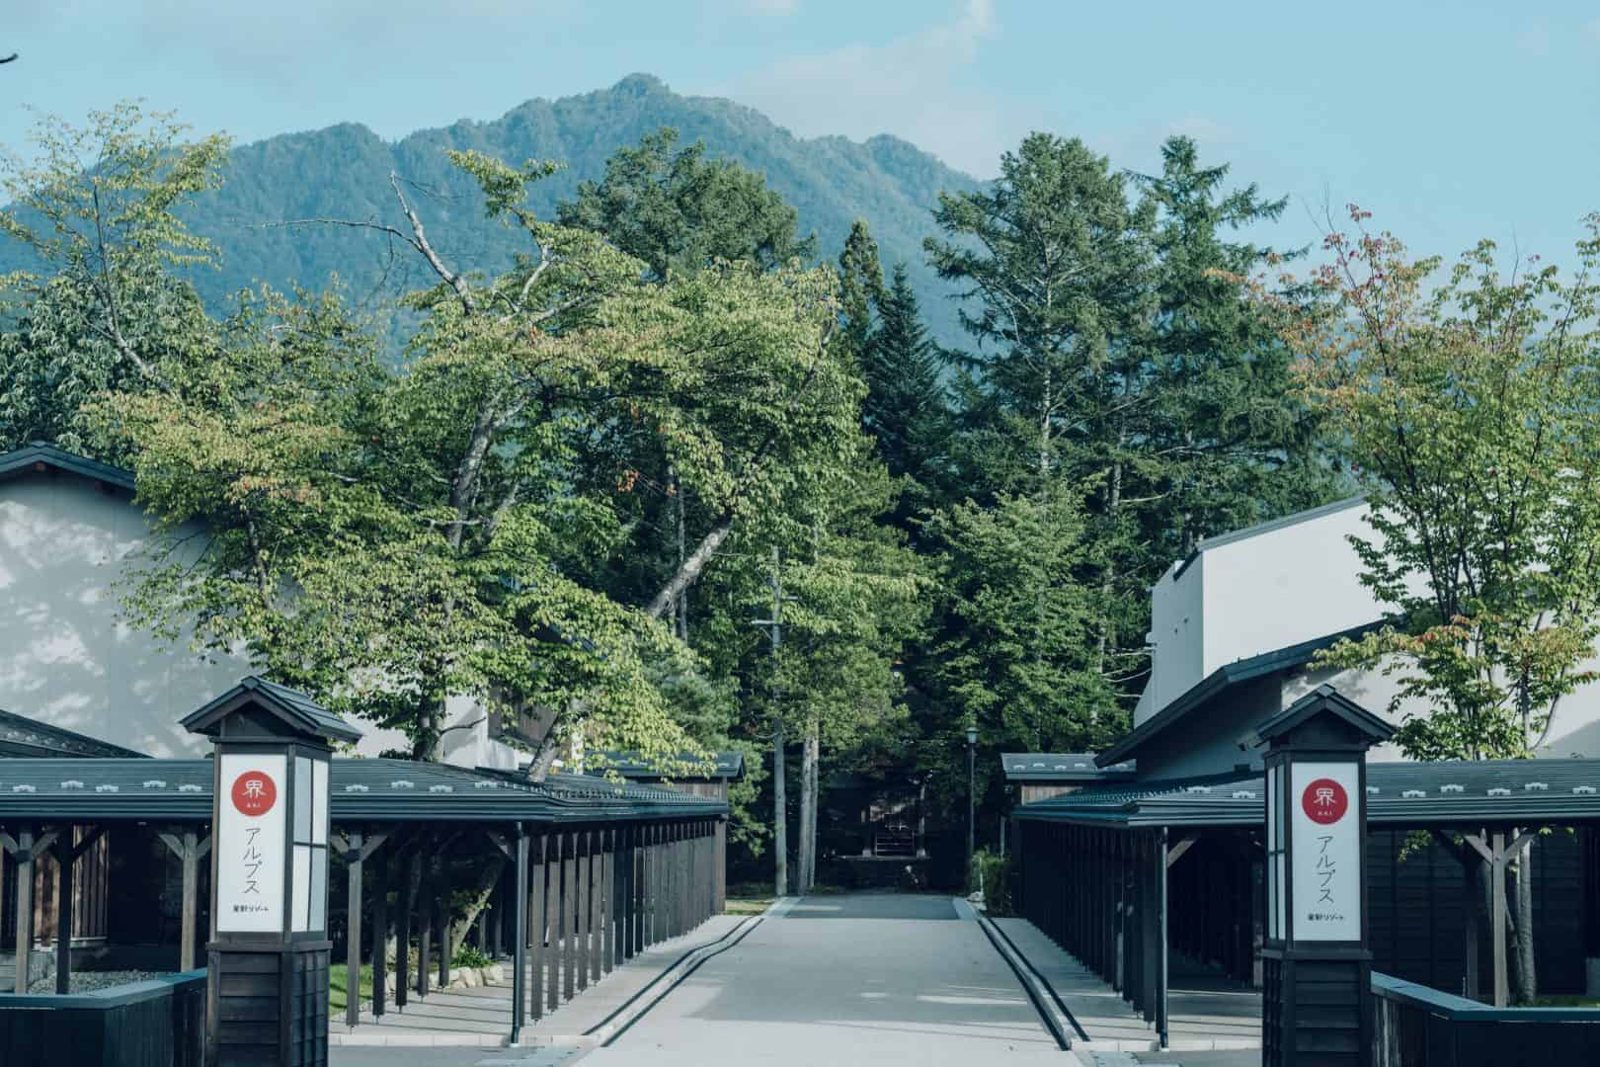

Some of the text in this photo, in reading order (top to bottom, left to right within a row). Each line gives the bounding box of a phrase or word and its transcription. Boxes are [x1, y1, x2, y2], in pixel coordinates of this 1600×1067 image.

[242, 780, 266, 798] 界
[1313, 787, 1337, 806] 界
[241, 827, 262, 894] アルプス
[1316, 836, 1336, 904] アルプス
